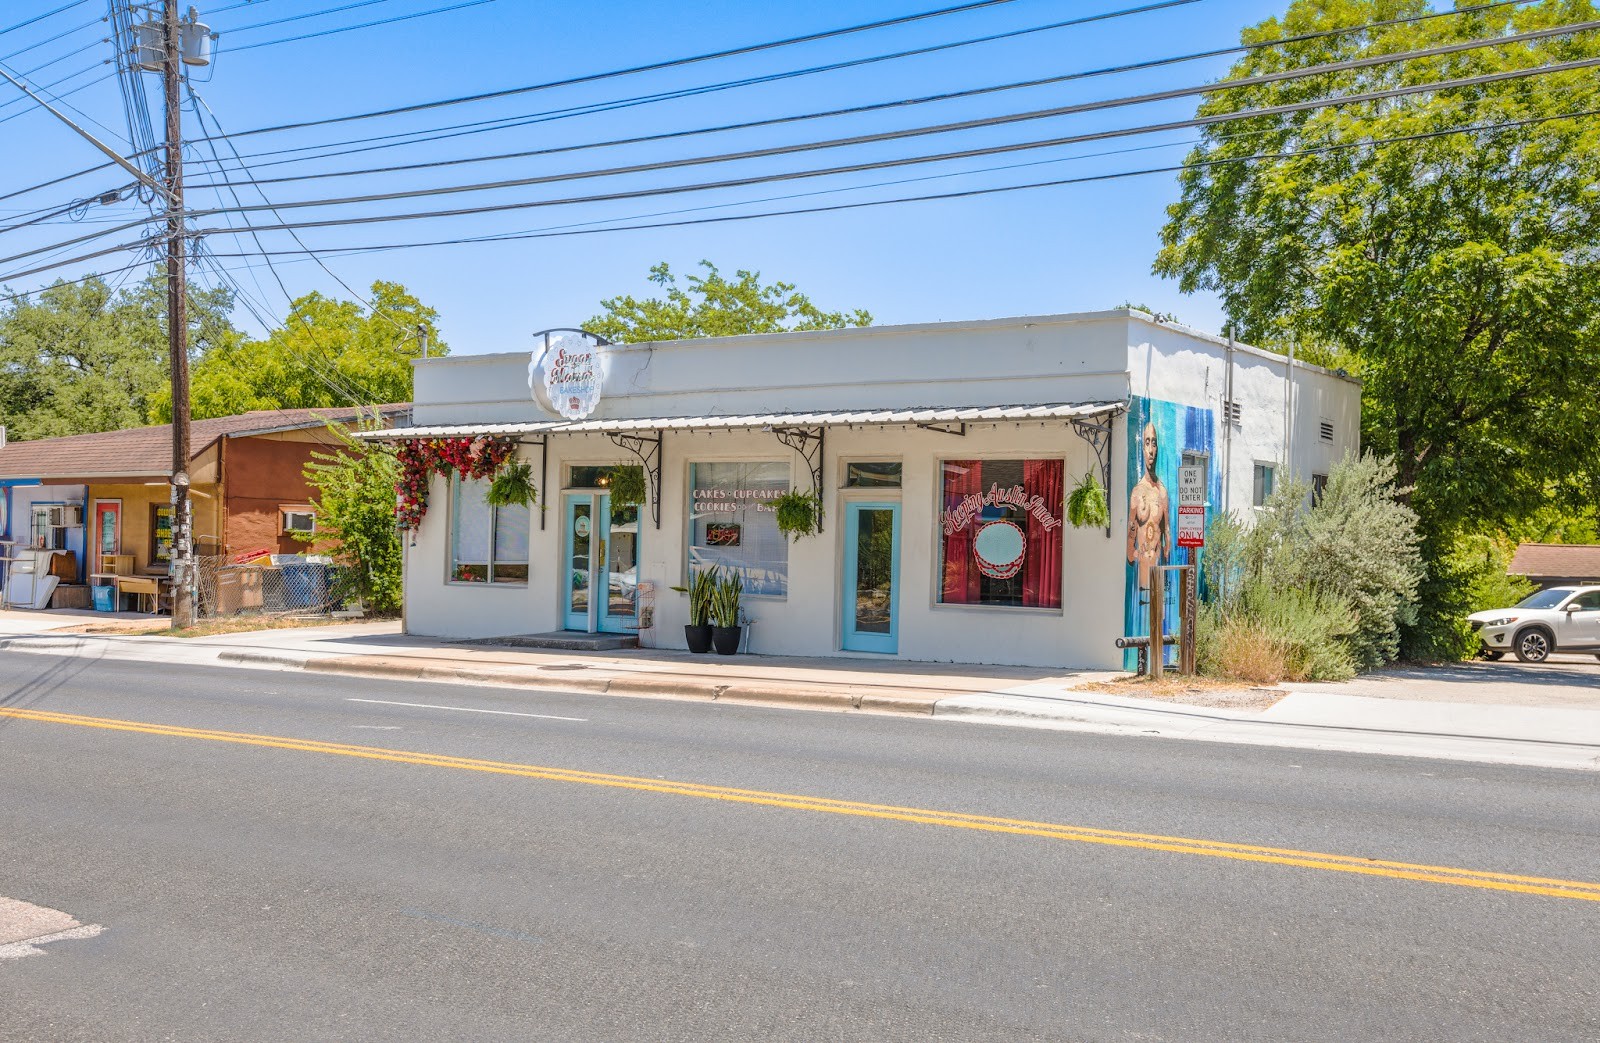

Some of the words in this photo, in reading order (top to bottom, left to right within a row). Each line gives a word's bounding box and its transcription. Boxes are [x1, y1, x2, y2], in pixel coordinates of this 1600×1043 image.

[555, 348, 592, 369] Sugar
[560, 385, 594, 395] BAKESHOP
[1184, 470, 1197, 478] ONE
[692, 489, 726, 499] CAKES
[733, 489, 787, 499] CUPCAKES
[694, 502, 737, 512] COOKIES
[940, 491, 984, 536] Keeping
[983, 481, 1028, 512] Austin
[1024, 494, 1062, 533] Sweet
[1179, 531, 1203, 539] ONLY
